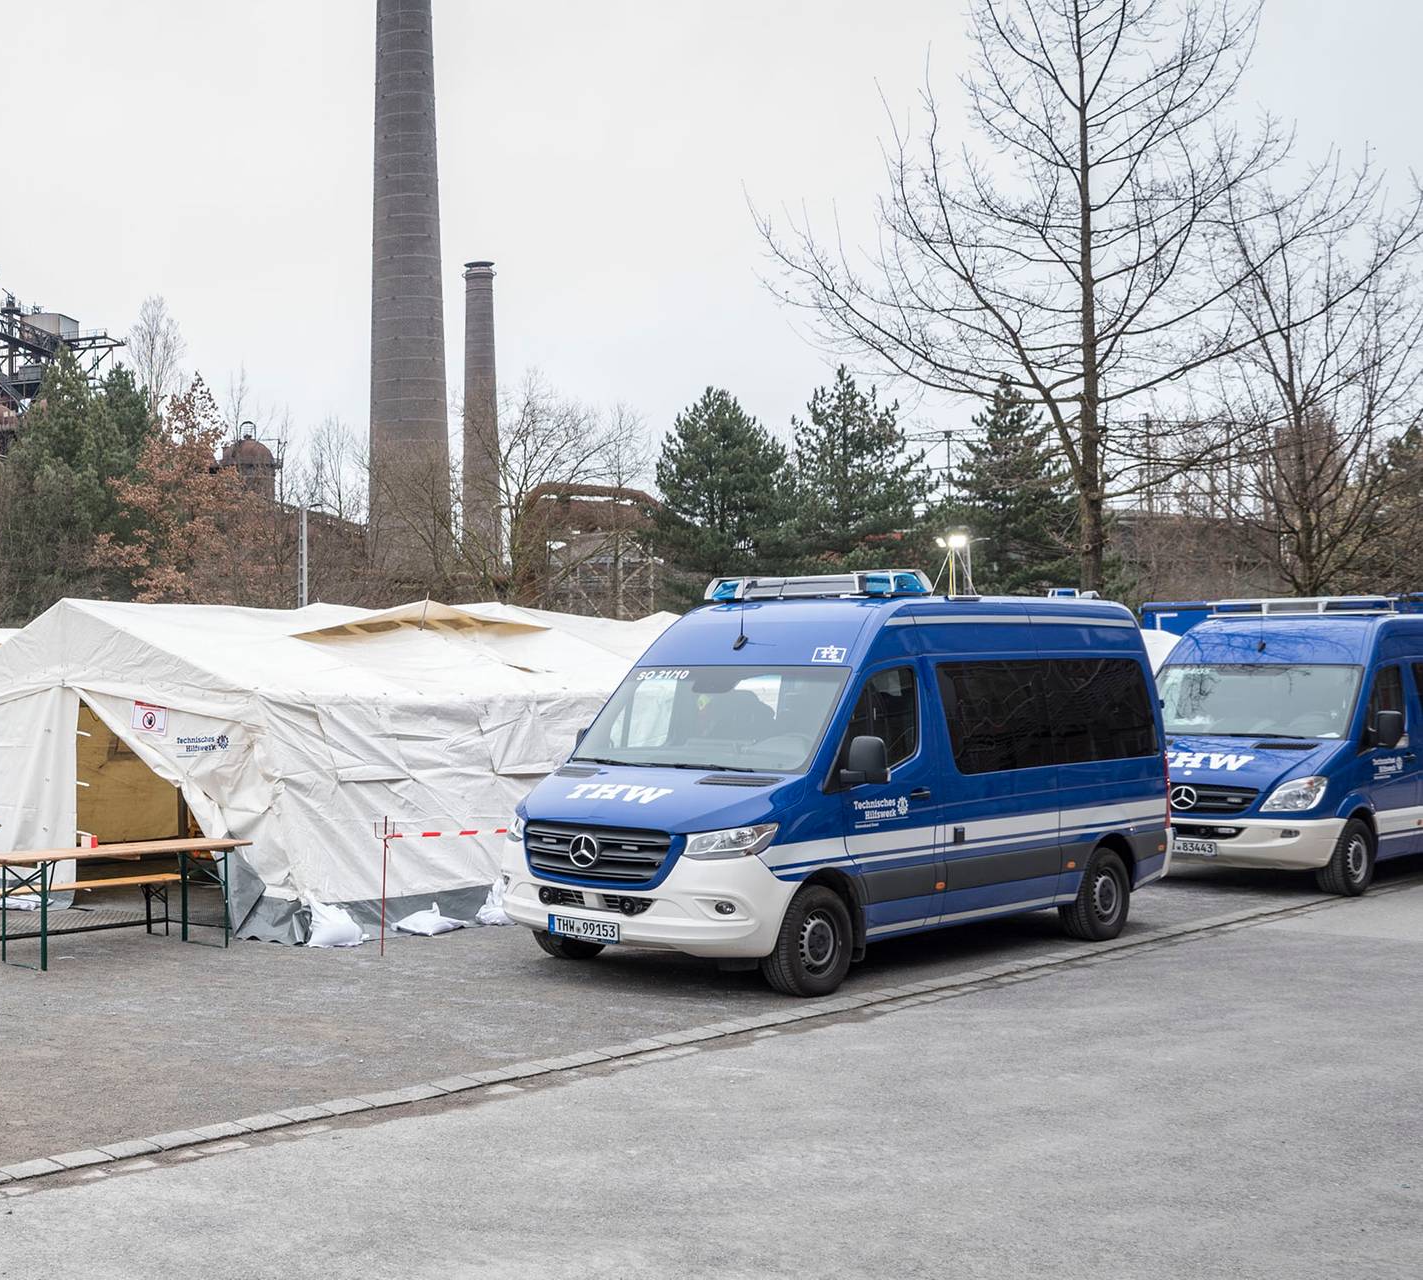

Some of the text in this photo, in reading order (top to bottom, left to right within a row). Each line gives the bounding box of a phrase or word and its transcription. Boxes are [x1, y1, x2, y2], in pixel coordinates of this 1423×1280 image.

[636, 670, 690, 681] SO 21/10
[177, 736, 215, 745] Technisches
[186, 744, 217, 752] Hilfswerk
[1167, 752, 1255, 771] HW
[565, 784, 674, 804] THW
[854, 798, 896, 810] Technisches
[865, 808, 897, 820] Hilfswerk
[1182, 842, 1214, 853] 83443
[556, 918, 575, 932] THW
[582, 922, 616, 938] 99153
